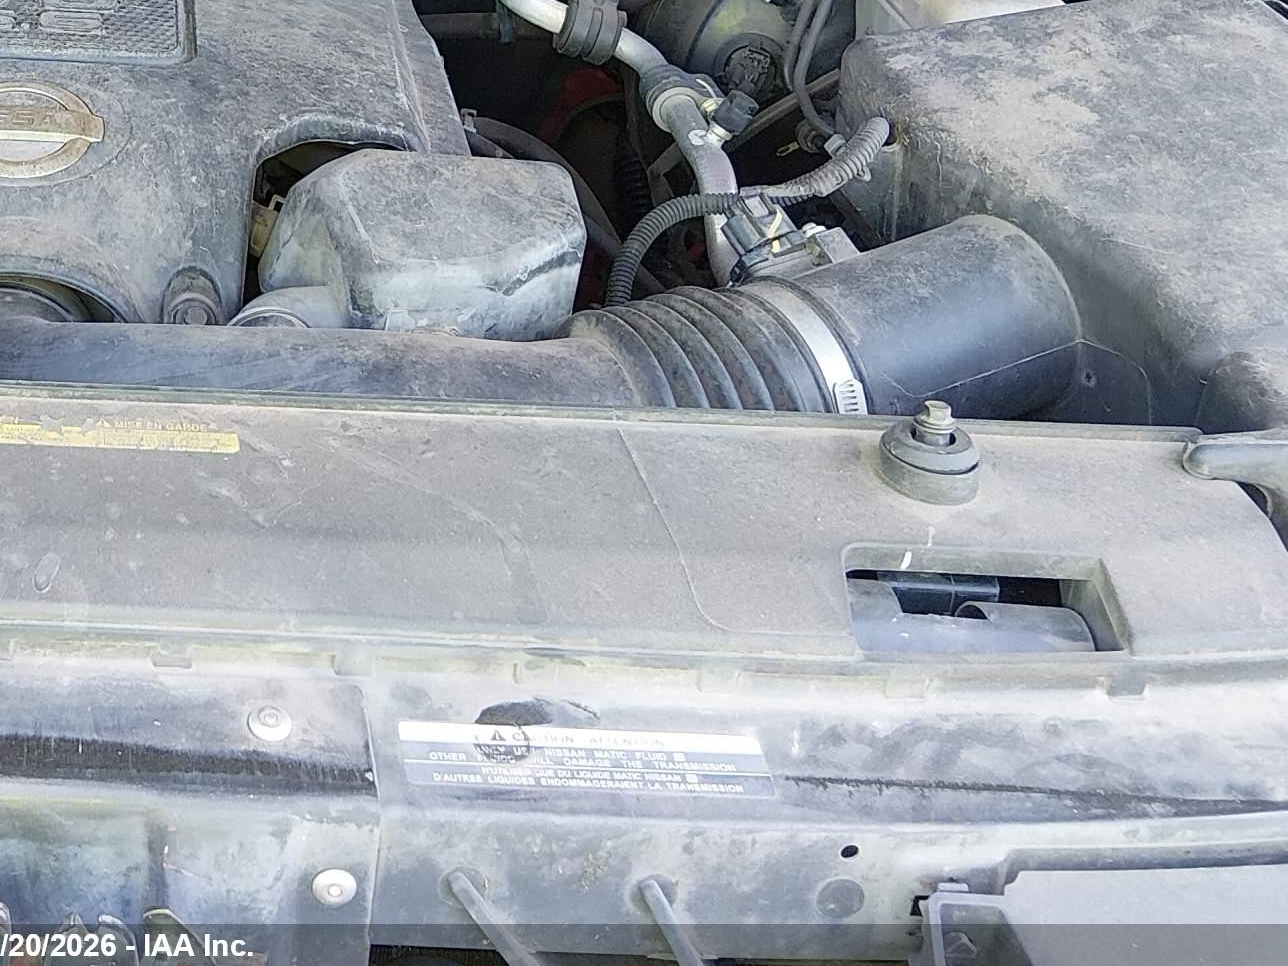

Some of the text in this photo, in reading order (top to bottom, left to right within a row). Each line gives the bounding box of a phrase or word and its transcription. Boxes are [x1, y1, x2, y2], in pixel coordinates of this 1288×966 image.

[146, 421, 161, 430] EN
[166, 422, 208, 433] GARDE
[429, 751, 466, 761] OTHER
[563, 757, 610, 768] DAMAGE
[621, 760, 643, 769] THE
[652, 761, 737, 772] TRANSMISSION
[544, 747, 585, 758] NISSAN
[594, 750, 627, 760] MATIC
[636, 752, 667, 762] FLUID
[433, 772, 744, 794] D'AUTRES LIQUIDES ENDOMMAGERAIENT LA TRANSMISSION
[557, 769, 571, 779] DU
[574, 770, 611, 781] LIQUIDE
[613, 771, 642, 782] MATIC
[644, 772, 682, 783] NISSAN
